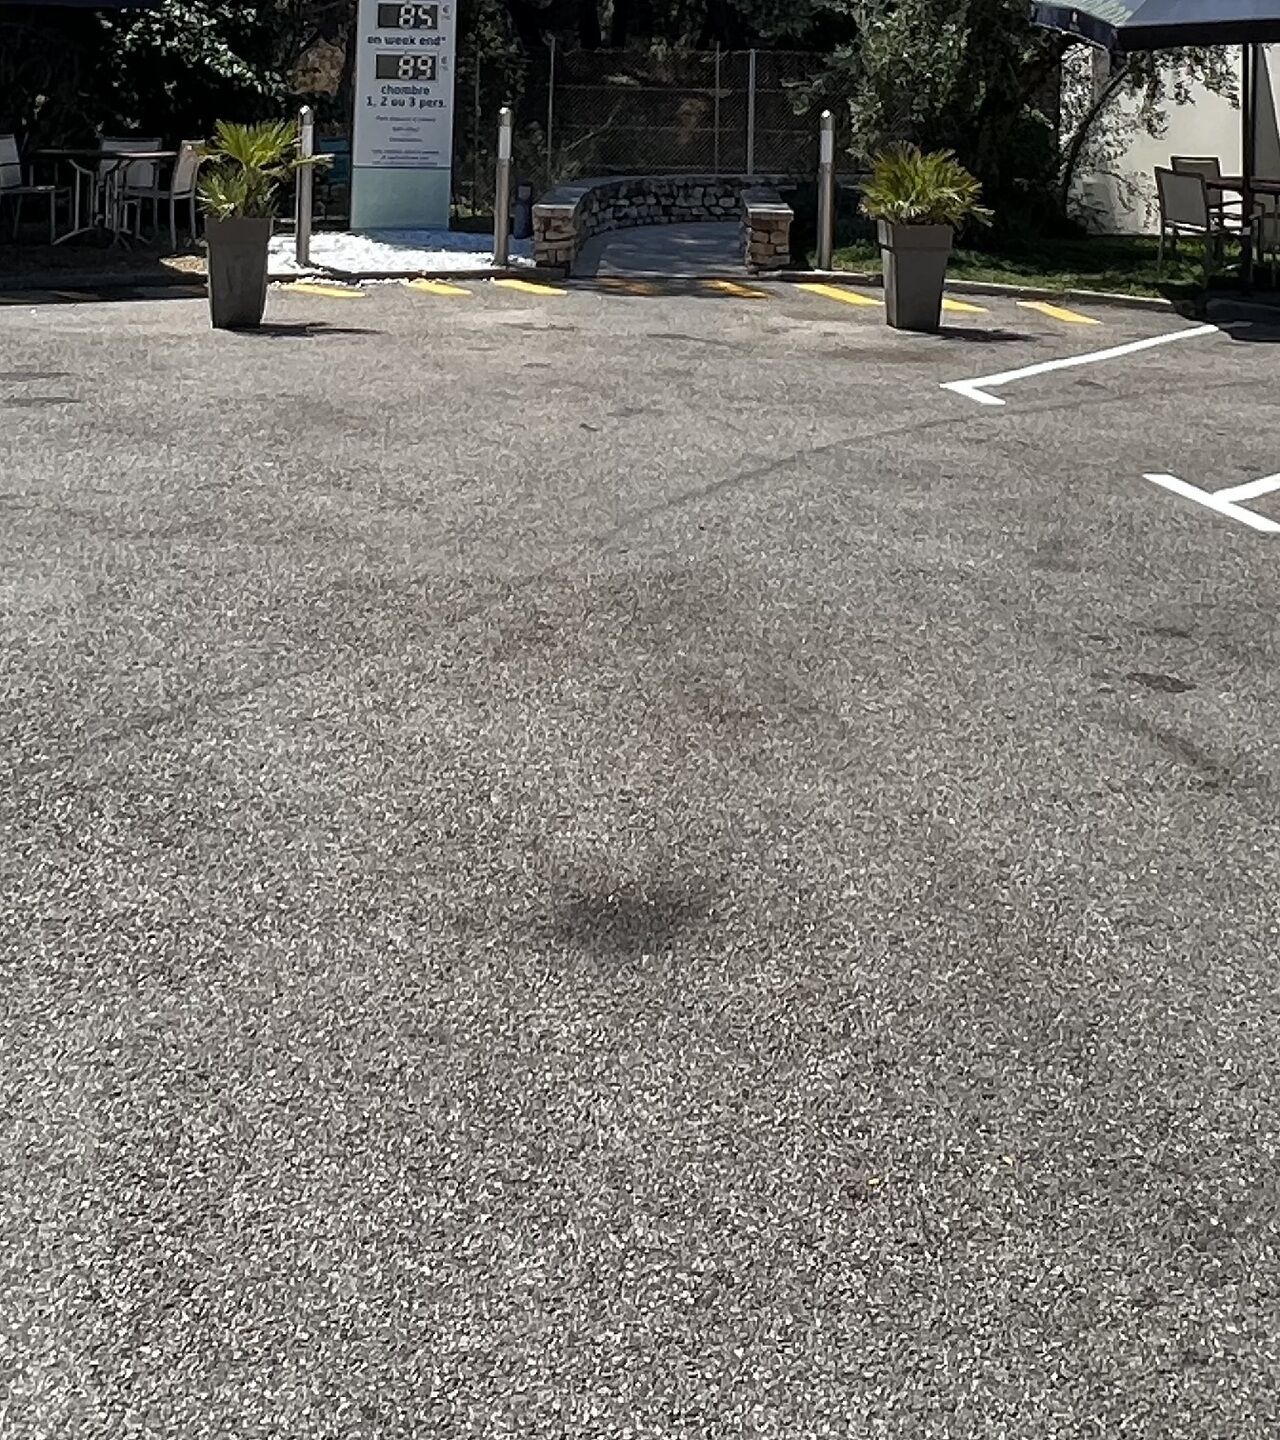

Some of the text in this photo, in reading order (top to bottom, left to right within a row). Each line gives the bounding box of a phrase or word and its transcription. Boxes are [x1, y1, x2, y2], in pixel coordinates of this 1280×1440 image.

[399, 4, 432, 29] 85
[367, 36, 382, 44] en
[385, 35, 416, 46] week
[398, 55, 432, 80] 89
[381, 85, 430, 95] chambre
[380, 96, 388, 107] 2
[391, 99, 405, 107] ou
[409, 97, 417, 107] 3
